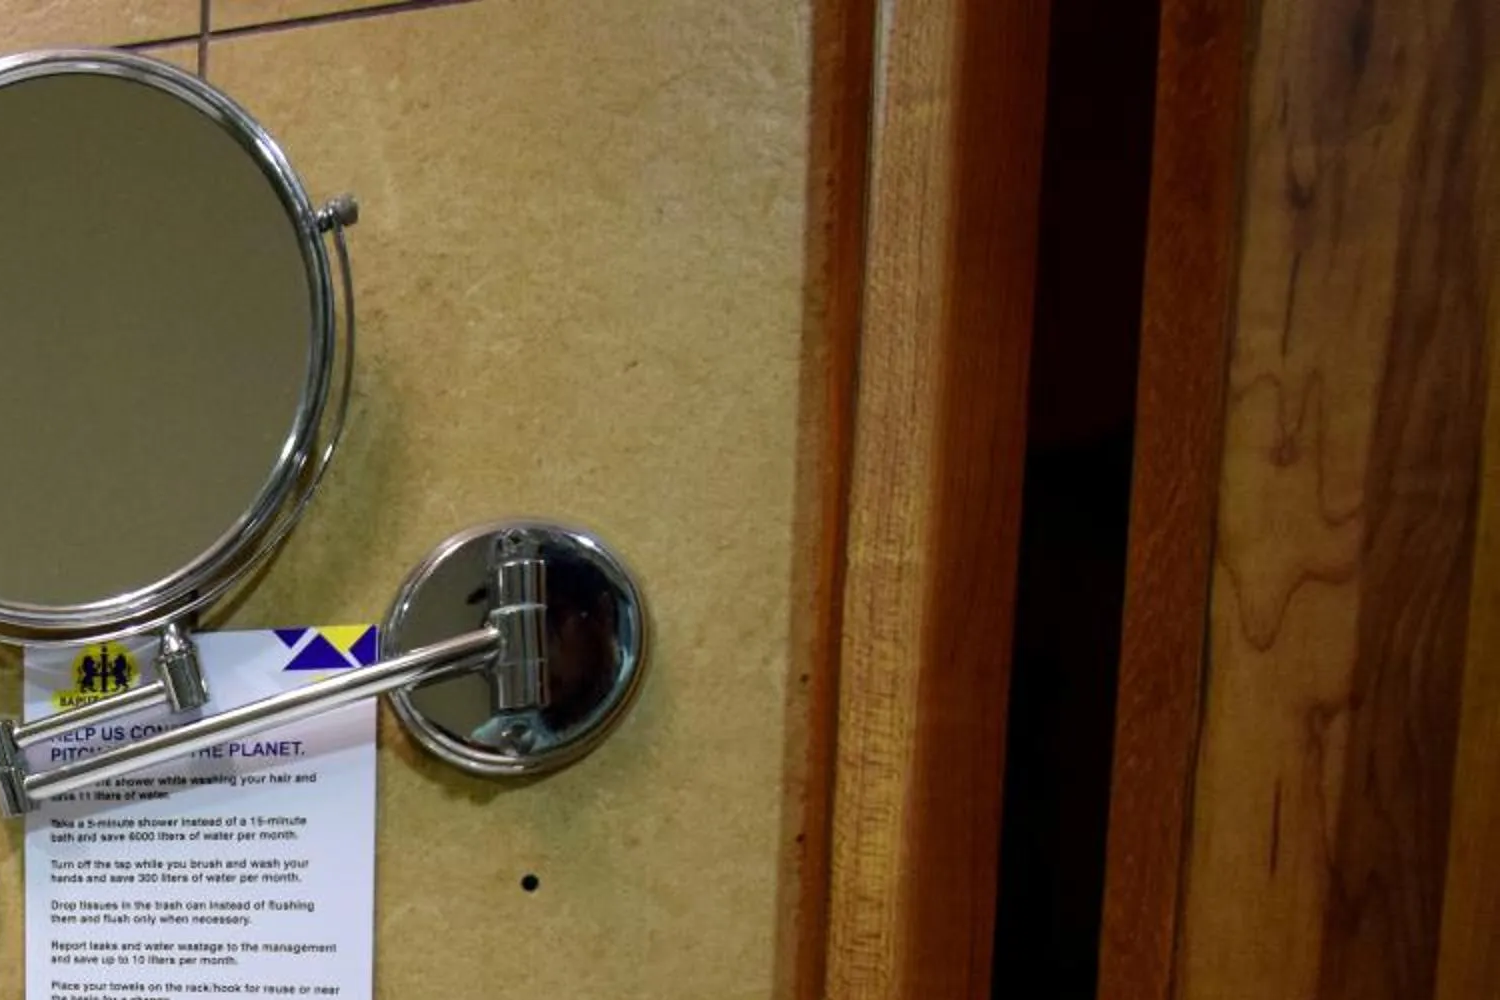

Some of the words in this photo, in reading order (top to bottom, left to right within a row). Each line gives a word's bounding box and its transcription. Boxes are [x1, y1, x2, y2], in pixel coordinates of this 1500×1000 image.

[52, 727, 96, 742] ELP
[102, 725, 125, 741] US
[229, 741, 305, 757] PLANET.
[114, 776, 154, 787] shower
[158, 775, 188, 786] while
[190, 774, 236, 787] washing
[240, 776, 266, 787] your
[268, 773, 292, 784] hair
[294, 773, 316, 784] and
[124, 790, 136, 801] of
[138, 789, 170, 800] water.
[50, 818, 76, 829] Take
[138, 817, 178, 828] shower
[180, 817, 222, 828] instead
[224, 816, 238, 827] of
[76, 832, 98, 843] and
[100, 833, 126, 842] save
[188, 831, 200, 842] of
[202, 830, 234, 841] water
[236, 832, 256, 843] per
[258, 830, 298, 841] month.
[52, 859, 74, 870] Turn
[76, 859, 92, 870] off
[94, 859, 112, 870] the
[134, 859, 164, 870] while
[166, 860, 186, 872] you
[190, 858, 222, 869] brush
[226, 858, 248, 869] and
[250, 858, 280, 869] wash
[284, 860, 308, 871] your
[50, 873, 84, 884] hands
[86, 873, 106, 884] and
[110, 875, 136, 884] save
[192, 872, 204, 883] of
[206, 872, 236, 883] water
[240, 874, 258, 885] per
[262, 872, 302, 883] month.
[52, 900, 76, 913] Drop
[80, 900, 118, 911] tissues
[122, 900, 132, 911] in
[134, 900, 152, 911] the
[154, 900, 184, 911] trash
[186, 902, 206, 911] can
[208, 900, 250, 911] instead
[252, 900, 266, 911] of
[268, 900, 314, 913] flushing
[50, 913, 76, 924] them
[80, 913, 100, 924] and
[102, 913, 130, 924] flush
[134, 913, 156, 927] only
[160, 914, 190, 925] when
[50, 940, 86, 953] Report
[88, 941, 118, 952] leaks
[120, 941, 142, 952] and
[144, 941, 174, 952] water
[178, 941, 224, 955] wastage
[226, 942, 238, 953] to
[240, 942, 258, 953] the
[262, 942, 336, 955] management
[50, 953, 70, 964] and
[74, 955, 98, 964] save
[102, 956, 116, 967] up
[118, 954, 130, 965] to
[178, 956, 198, 968] per
[200, 955, 238, 966] month.
[52, 981, 82, 992] Place
[82, 983, 108, 994] your
[108, 982, 146, 993] towels
[148, 984, 162, 993] on
[164, 982, 182, 993] the
[244, 983, 260, 994] for
[264, 986, 296, 995] reuse
[298, 986, 310, 995] or
[314, 986, 340, 995] near
